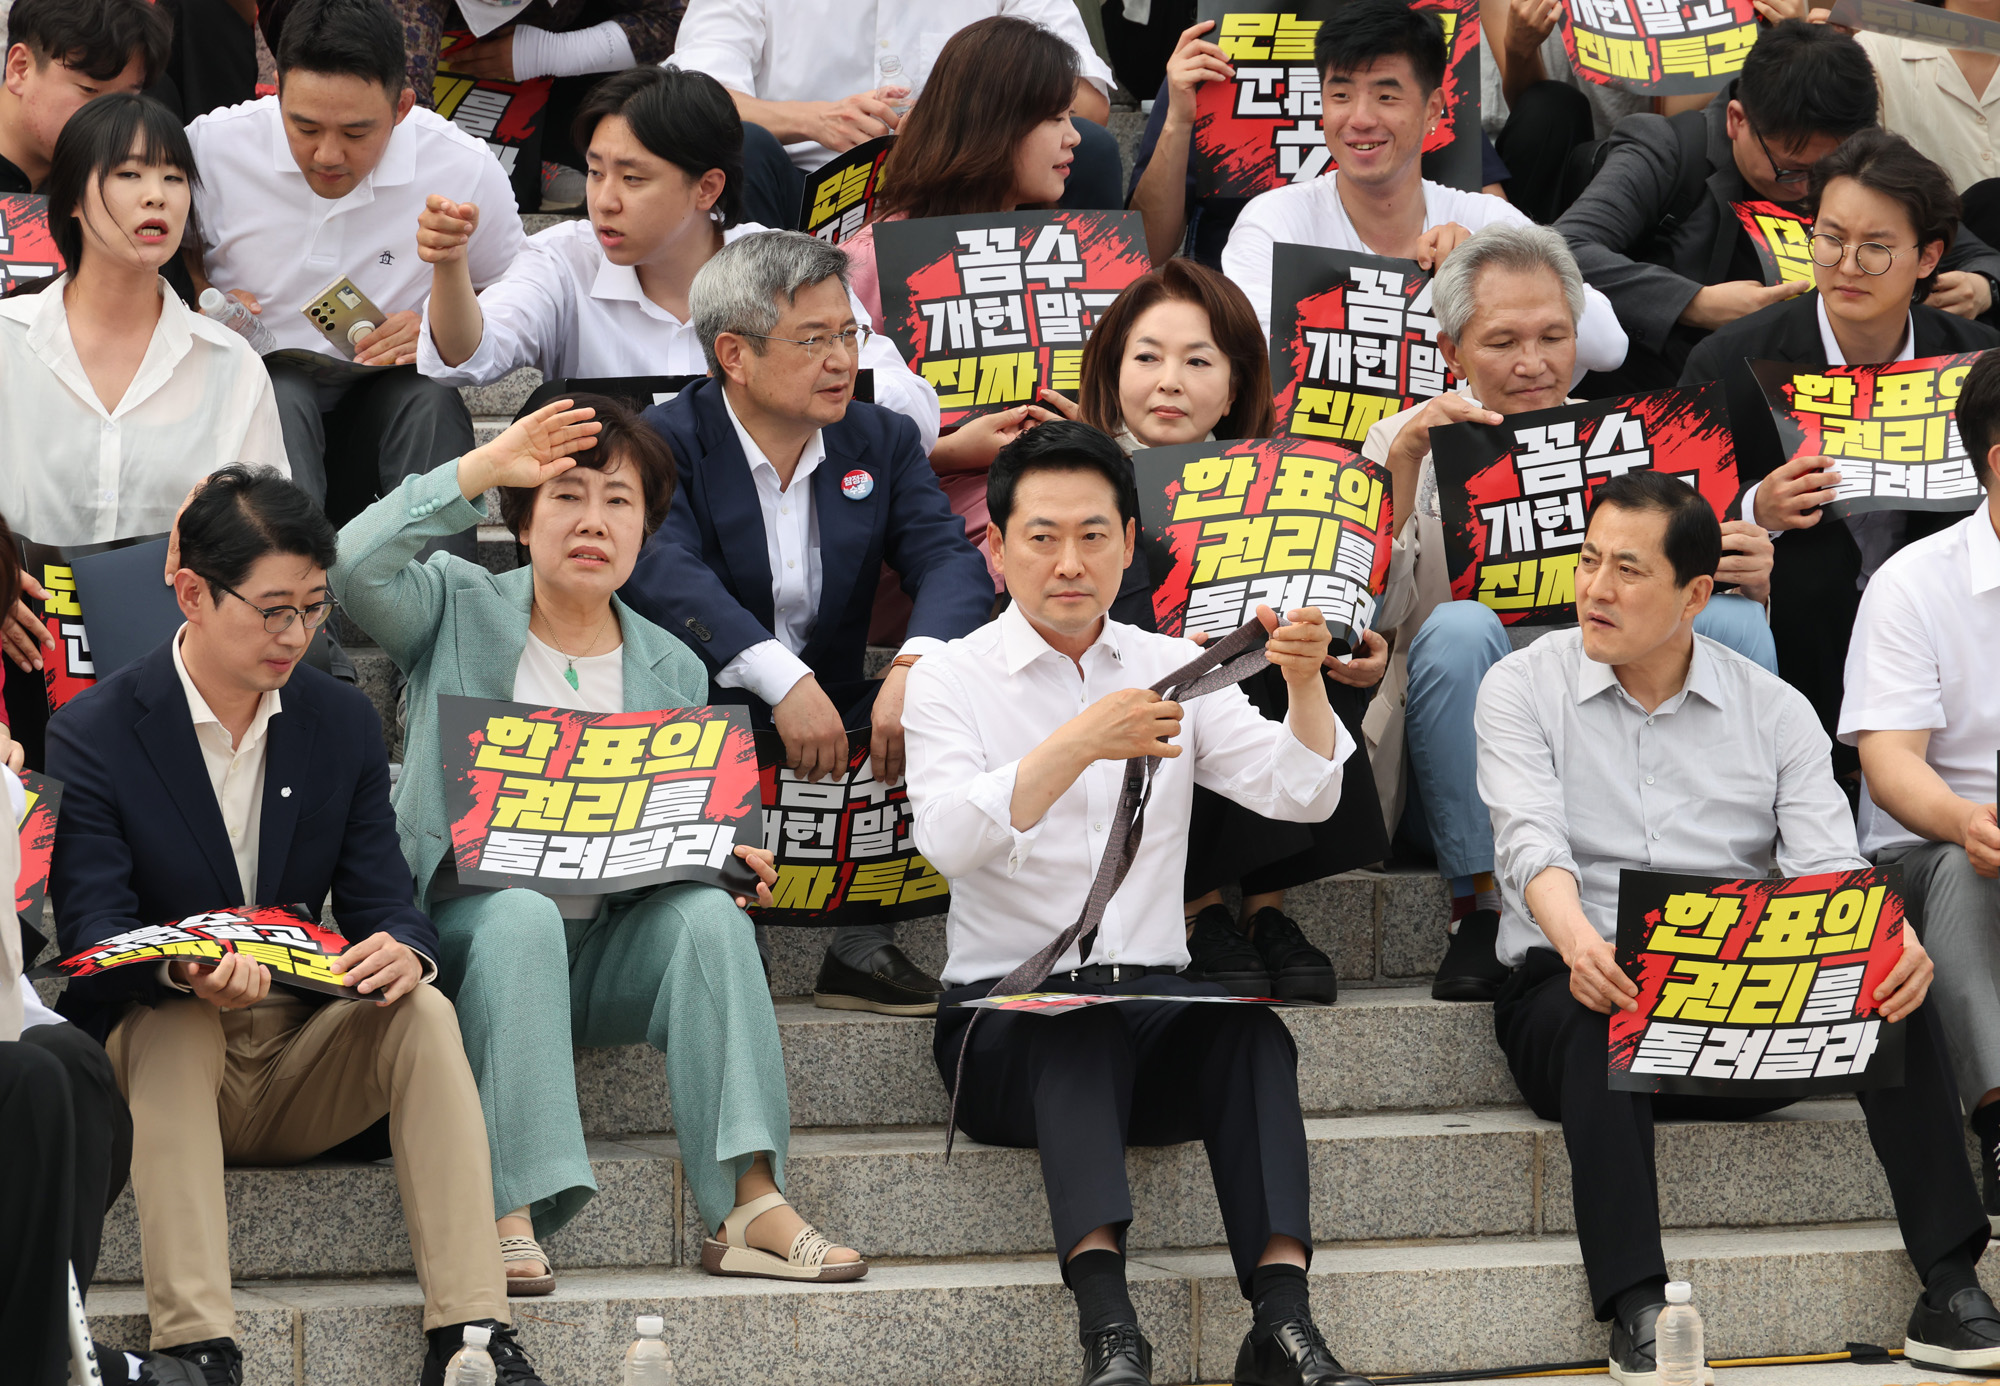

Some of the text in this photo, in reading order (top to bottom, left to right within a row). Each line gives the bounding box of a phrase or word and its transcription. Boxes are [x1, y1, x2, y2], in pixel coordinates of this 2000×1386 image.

[1573, 23, 1758, 80] 진짜 특검
[956, 225, 1083, 294] 꼼수
[921, 294, 1027, 351] 개헌
[921, 351, 1038, 409] 진짜
[1305, 331, 1398, 390] 개헌
[1793, 373, 1856, 416] 한
[1514, 411, 1650, 496] 꼼수
[1172, 456, 1384, 532] 한 표의
[1480, 492, 1585, 556] 개헌
[1191, 515, 1376, 587] 권리를
[474, 715, 729, 778] 한 표의
[490, 776, 711, 832] 권리를
[478, 824, 737, 880] 돌려달라
[198, 924, 318, 950] 말고
[1646, 885, 1887, 958] 한 표의
[96, 940, 349, 986] 진짜 특검
[1652, 959, 1865, 1024] 권리를
[1630, 1019, 1881, 1080] 돌려달라
